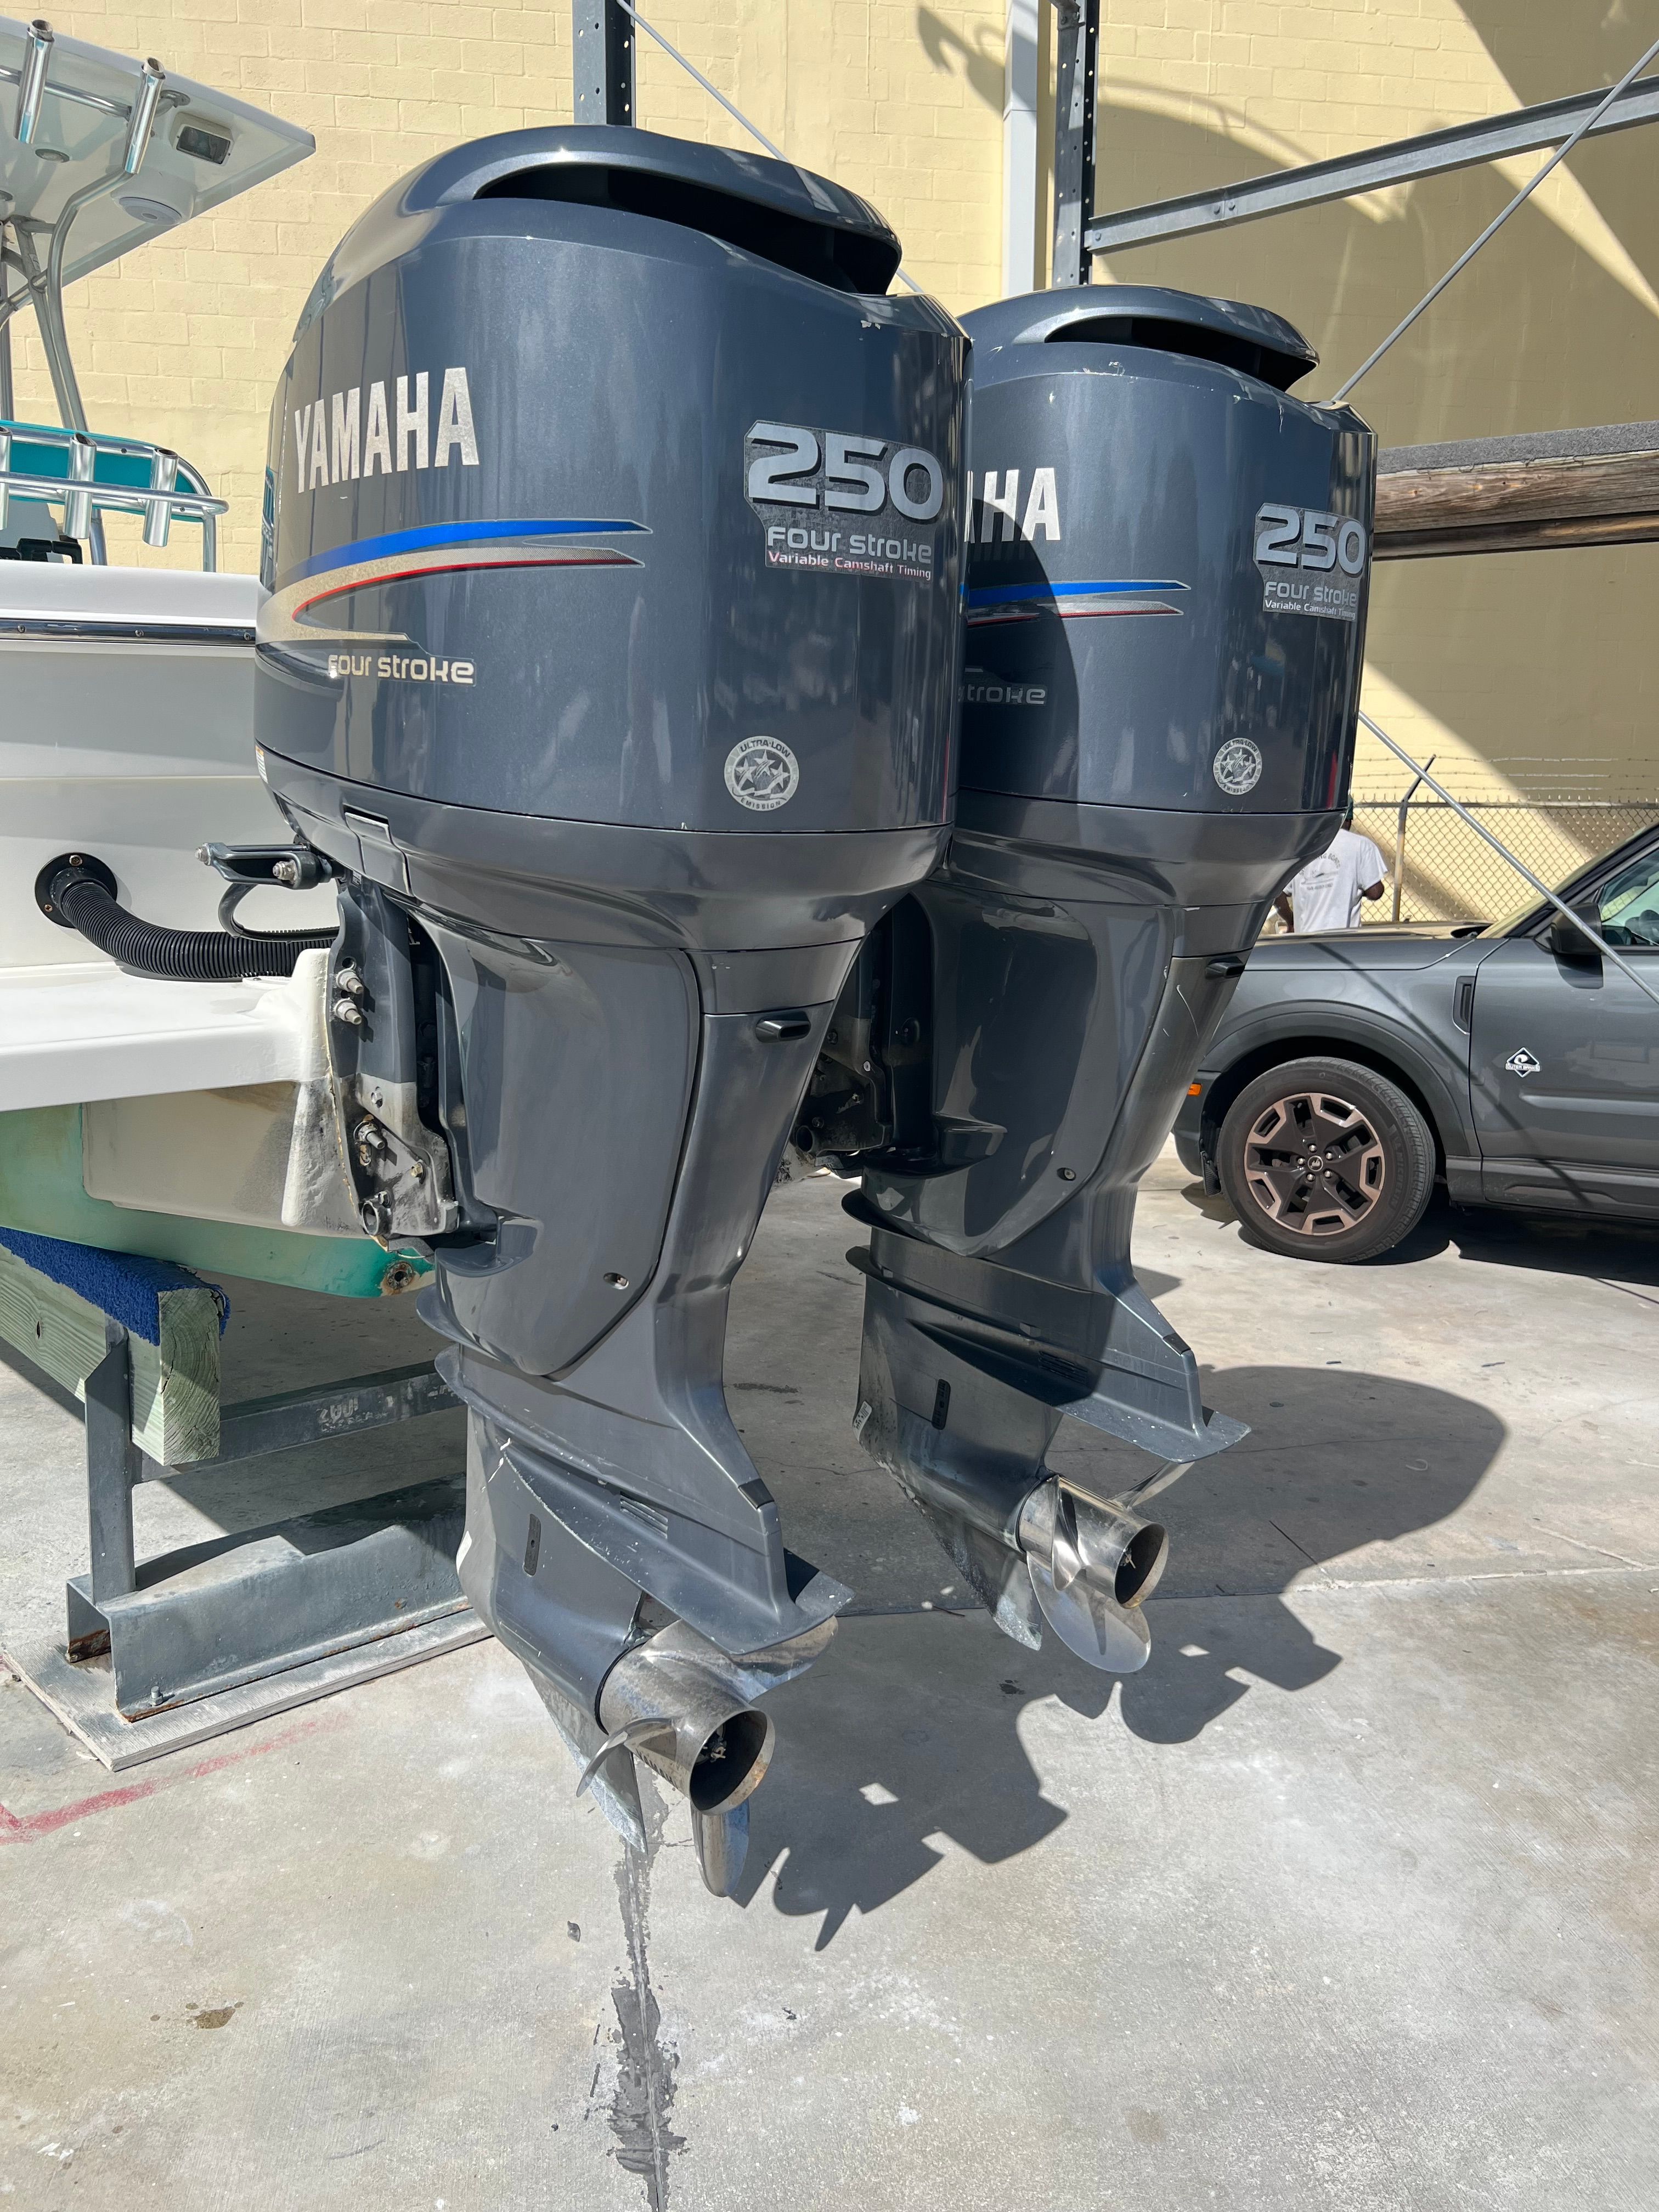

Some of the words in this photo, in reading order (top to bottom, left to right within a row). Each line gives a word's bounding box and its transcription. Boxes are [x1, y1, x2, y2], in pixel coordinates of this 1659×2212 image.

[295, 367, 479, 493] YAMAHA
[747, 422, 943, 521] 250
[1256, 505, 1365, 575] 250
[769, 551, 829, 567] Variable
[834, 557, 893, 573] Camshaft
[897, 564, 932, 581] Timing
[1265, 600, 1301, 611] Variable
[1304, 603, 1337, 616] Camshaft
[1339, 608, 1356, 620] Timing
[958, 684, 1046, 704] troke
[741, 798, 781, 809] EMISSION
